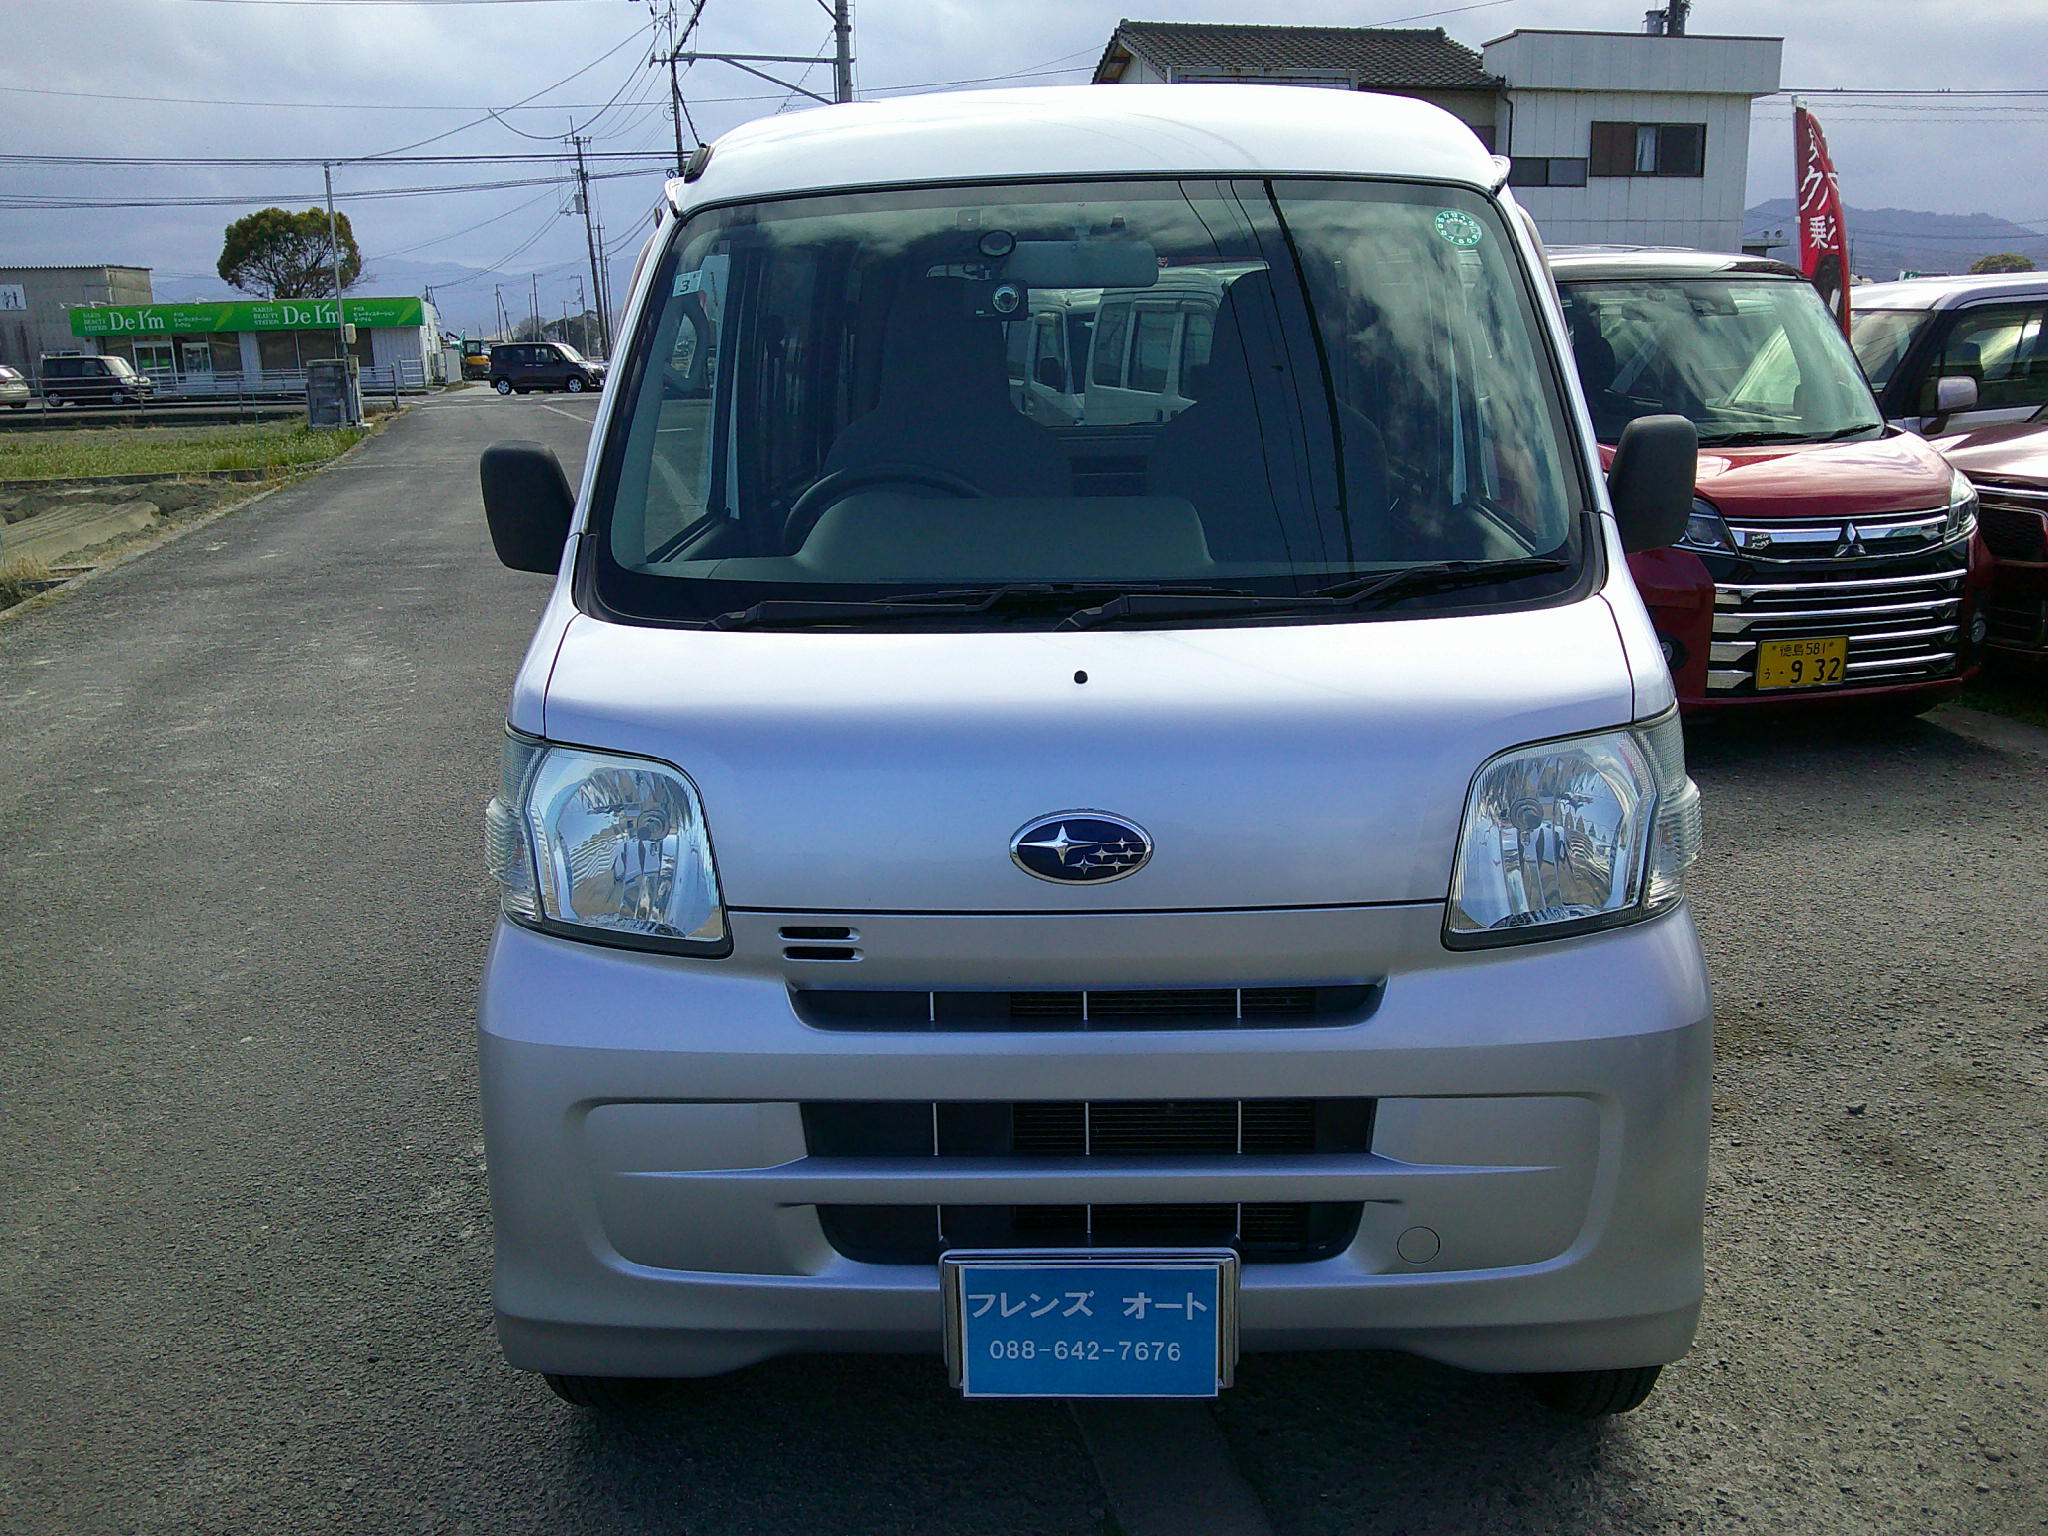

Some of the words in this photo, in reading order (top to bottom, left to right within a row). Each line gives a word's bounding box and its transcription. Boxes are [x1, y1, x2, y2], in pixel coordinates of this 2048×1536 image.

[108, 311, 136, 331] De
[138, 309, 165, 330] I'm
[282, 306, 311, 325] De
[1779, 644, 1804, 657] 徳島
[1806, 642, 1826, 655] 581
[967, 1290, 1096, 1318] フレンズ
[1122, 1291, 1208, 1320] オート
[989, 1340, 1182, 1362] 088-642-7676
